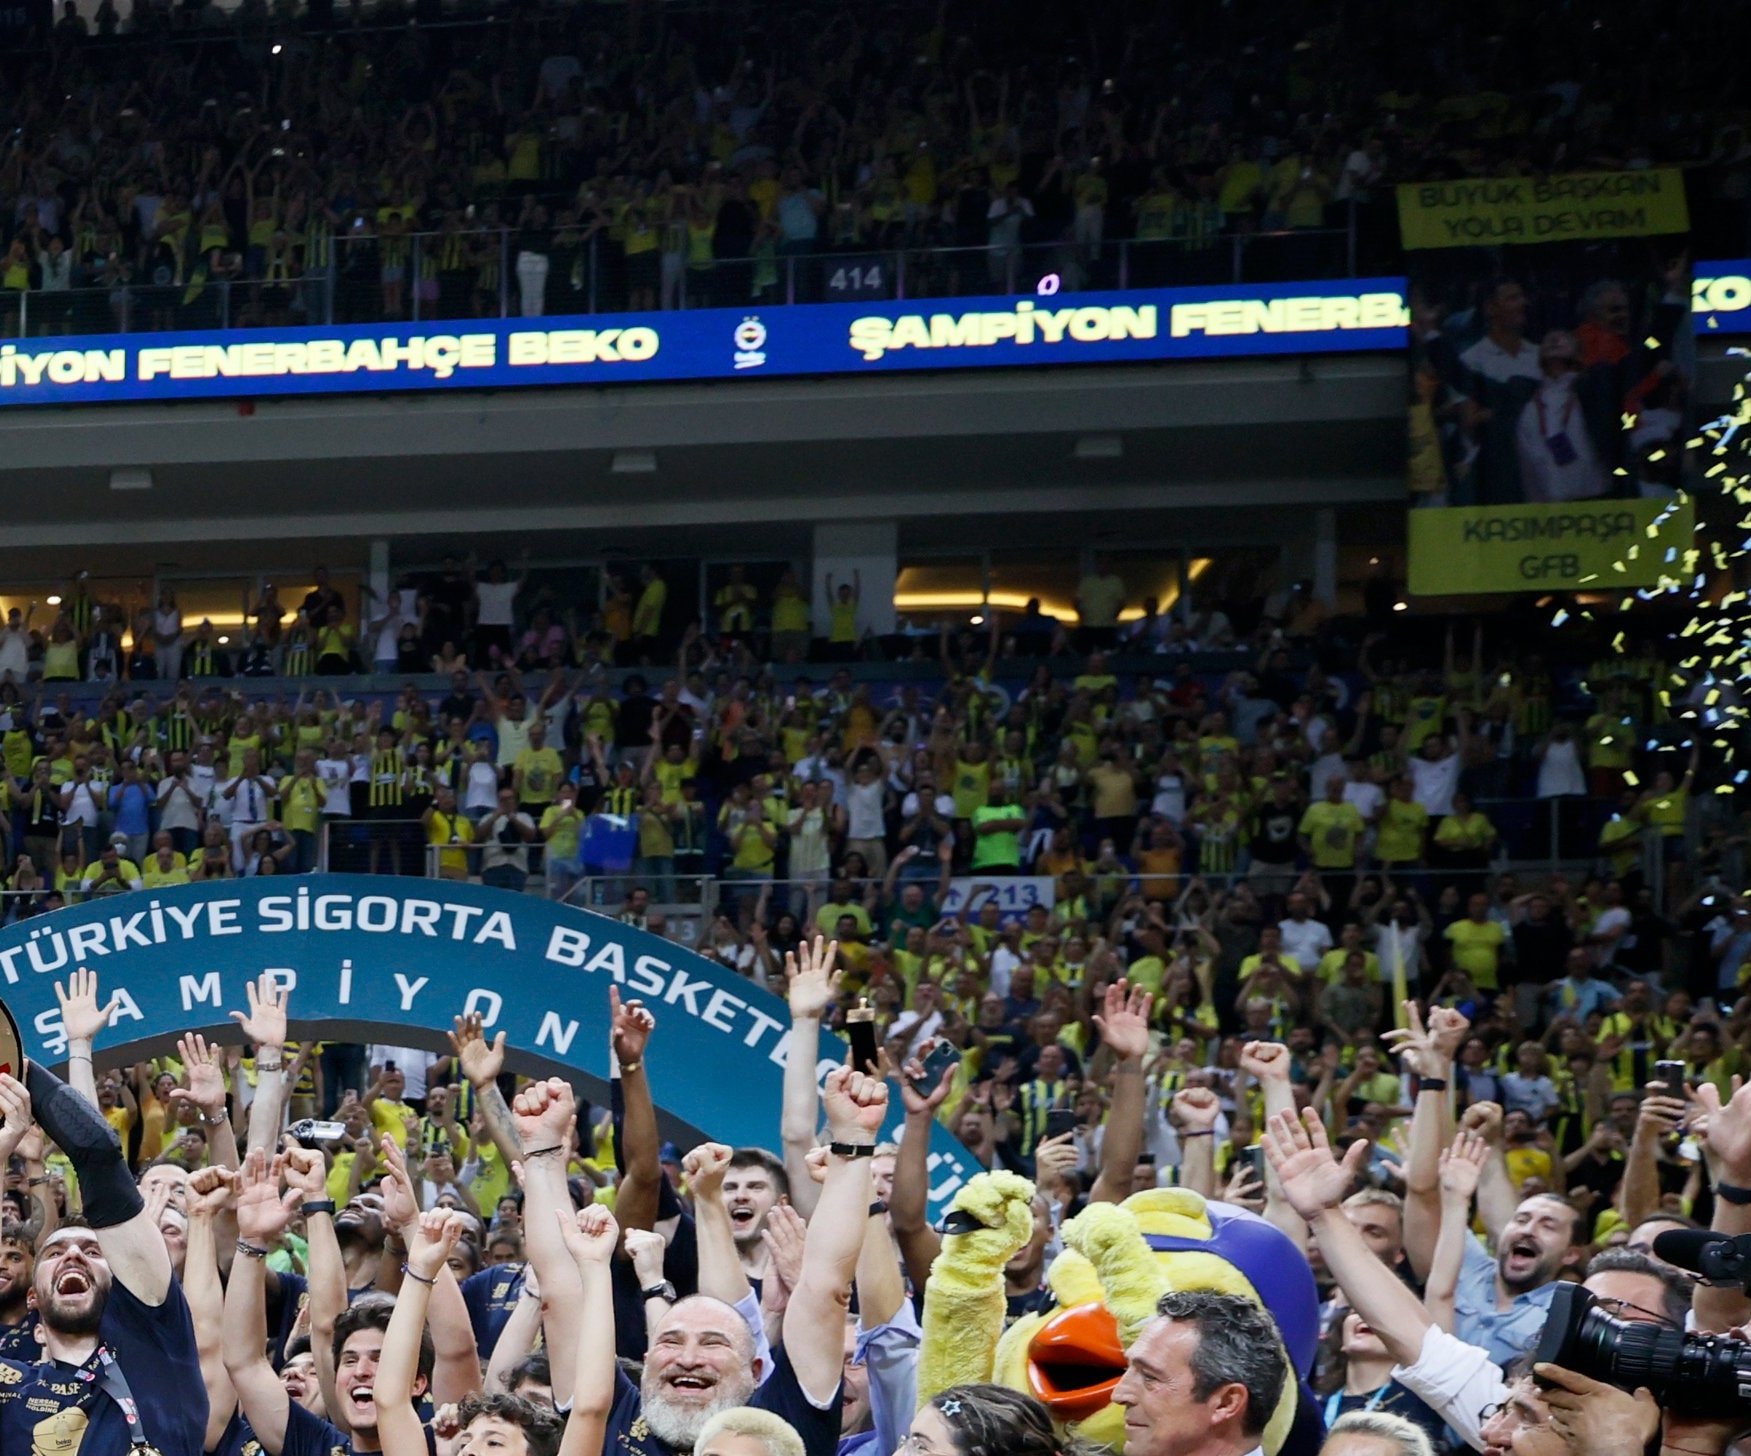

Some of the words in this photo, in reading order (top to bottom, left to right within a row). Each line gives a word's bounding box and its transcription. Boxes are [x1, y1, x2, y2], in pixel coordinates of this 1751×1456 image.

[830, 264, 882, 291] 414
[848, 299, 1156, 361] ŞAMPİYON
[138, 333, 496, 382] FENERBAHÇE
[508, 326, 660, 366] BEKO
[1519, 553, 1580, 580] GFB
[988, 884, 1039, 905] 213
[258, 886, 517, 951] SİGORTA
